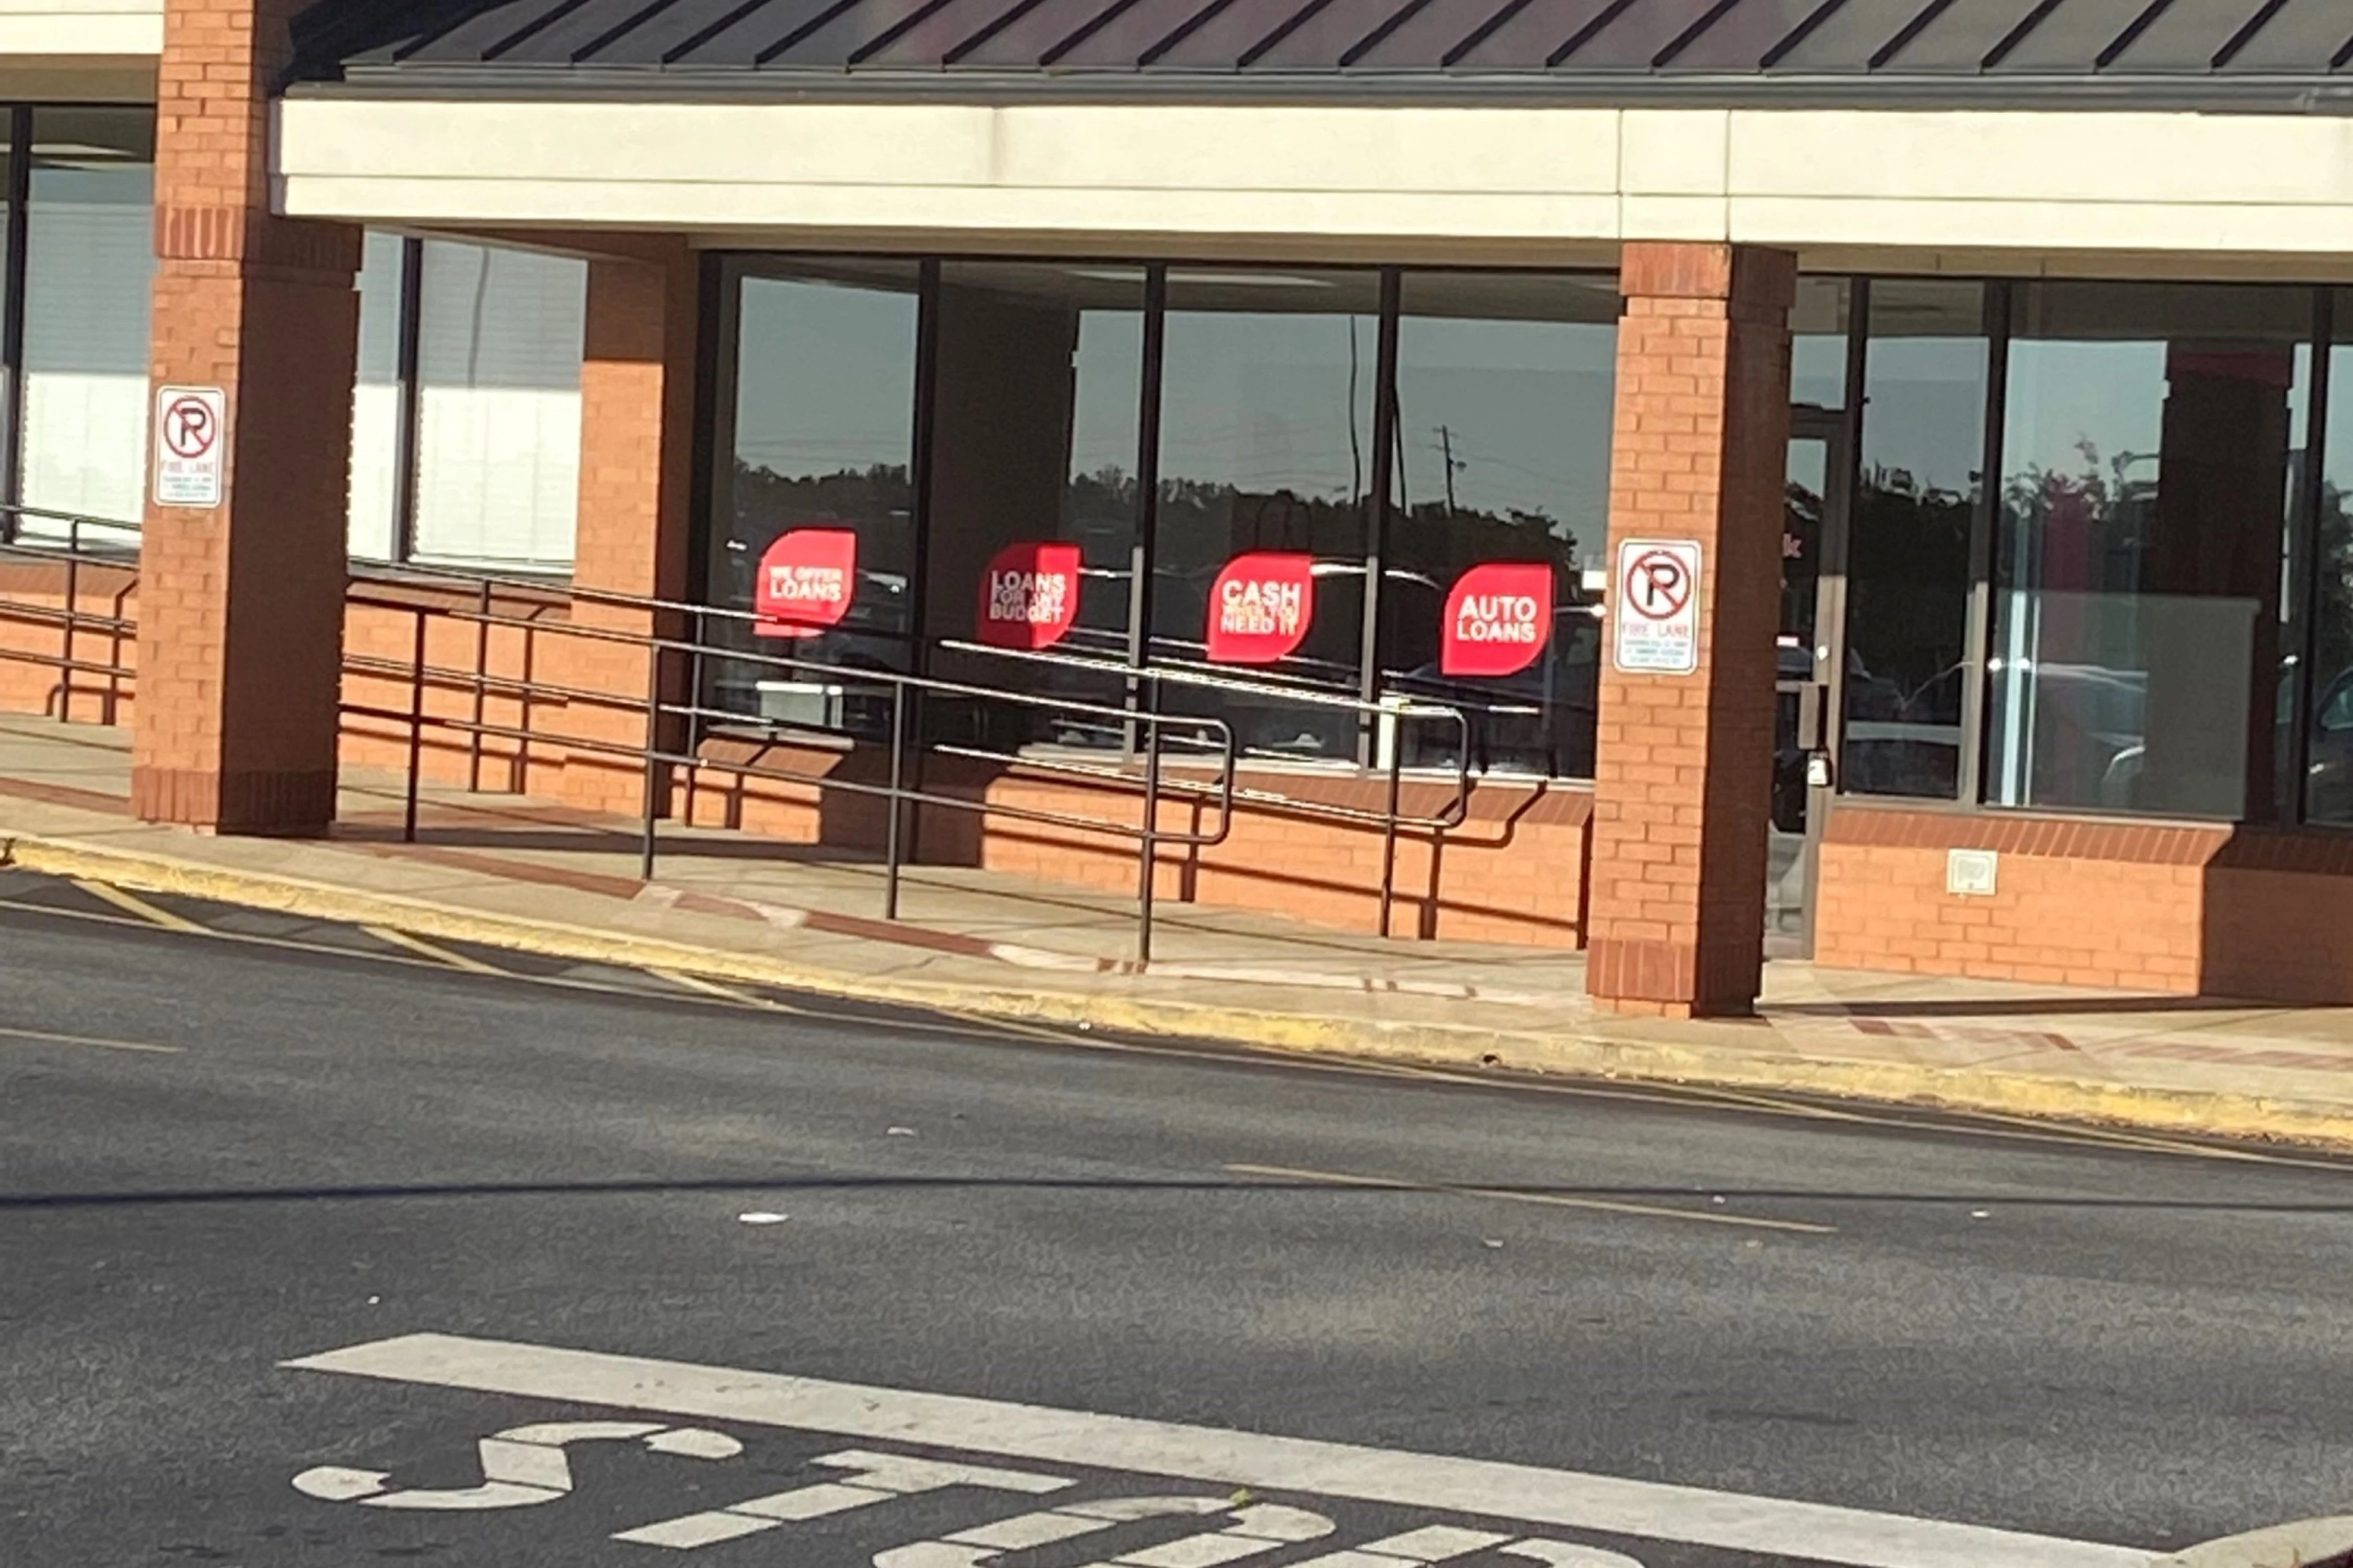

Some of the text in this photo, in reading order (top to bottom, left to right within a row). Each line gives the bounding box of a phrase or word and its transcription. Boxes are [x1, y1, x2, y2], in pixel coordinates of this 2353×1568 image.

[770, 580, 842, 602] LOANS
[991, 570, 1066, 593] LOANS
[1222, 580, 1301, 607] CASH
[989, 603, 1064, 623] BUDGET
[1458, 594, 1537, 621] AUTO
[1221, 616, 1298, 635] NEED IT
[1456, 619, 1536, 643] LOANS
